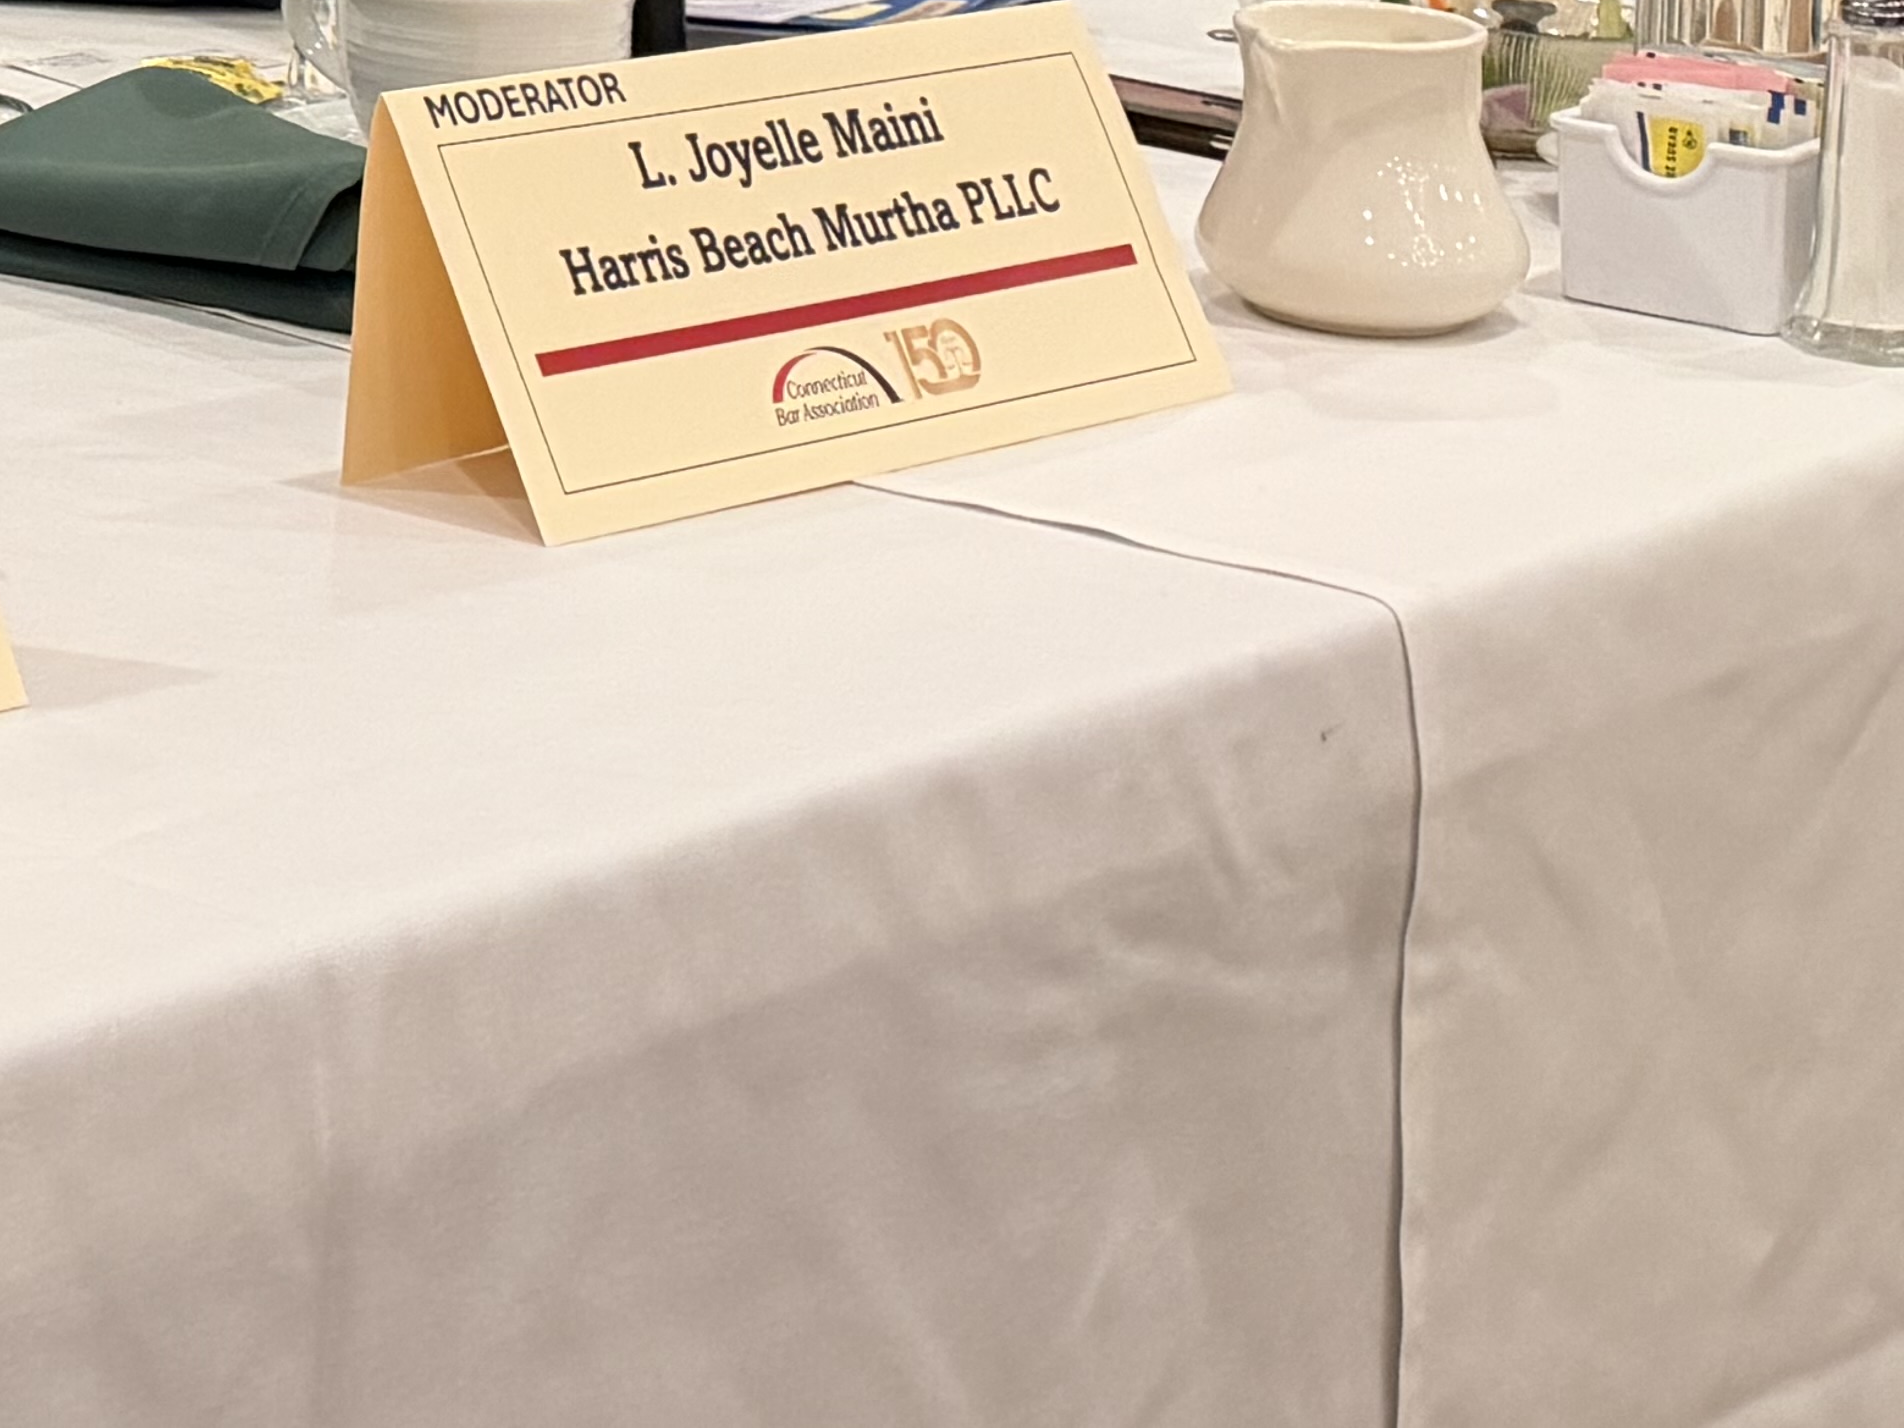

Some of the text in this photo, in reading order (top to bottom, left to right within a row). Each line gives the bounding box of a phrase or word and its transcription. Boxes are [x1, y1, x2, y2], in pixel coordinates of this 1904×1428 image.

[423, 72, 627, 129] MODERATOR
[629, 96, 945, 189] L. Joyelle Maini
[558, 167, 1061, 296] Harris Beach Murtha PLLC
[786, 369, 868, 400] Connecticut
[882, 318, 982, 400] 150
[775, 393, 880, 427] Bar Association
